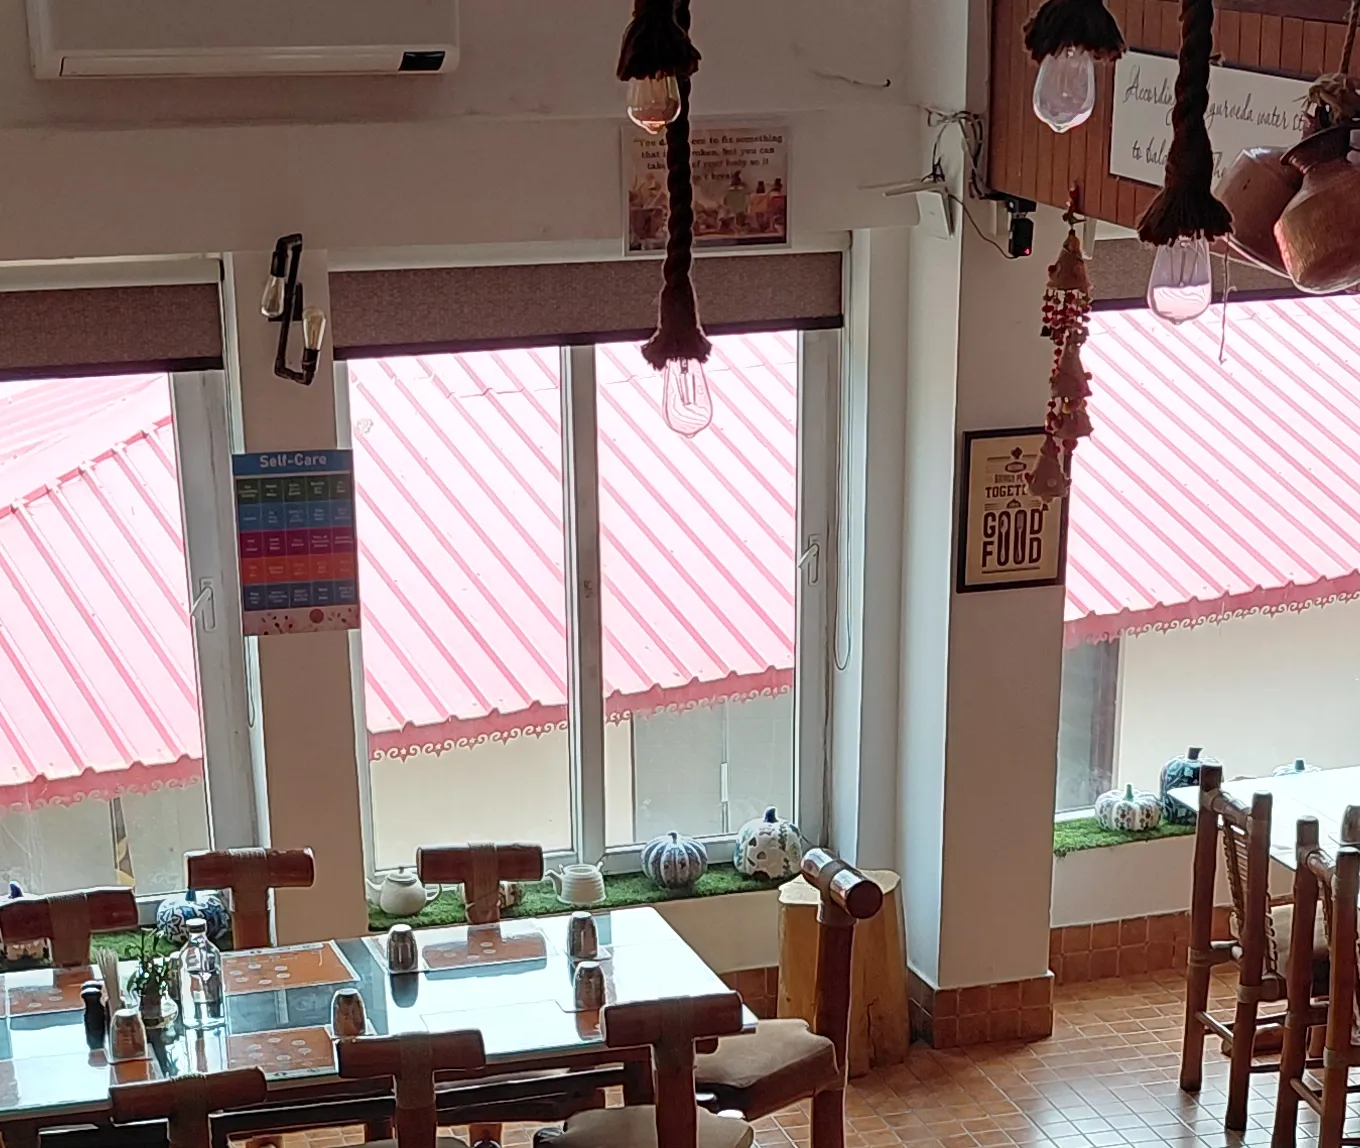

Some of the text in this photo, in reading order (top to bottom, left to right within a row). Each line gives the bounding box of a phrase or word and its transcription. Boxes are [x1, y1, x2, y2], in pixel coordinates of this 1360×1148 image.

[1257, 105, 1289, 130] water
[259, 453, 327, 468] Self-Care
[983, 508, 1043, 548] GOOD
[981, 530, 1042, 569] FOOD
